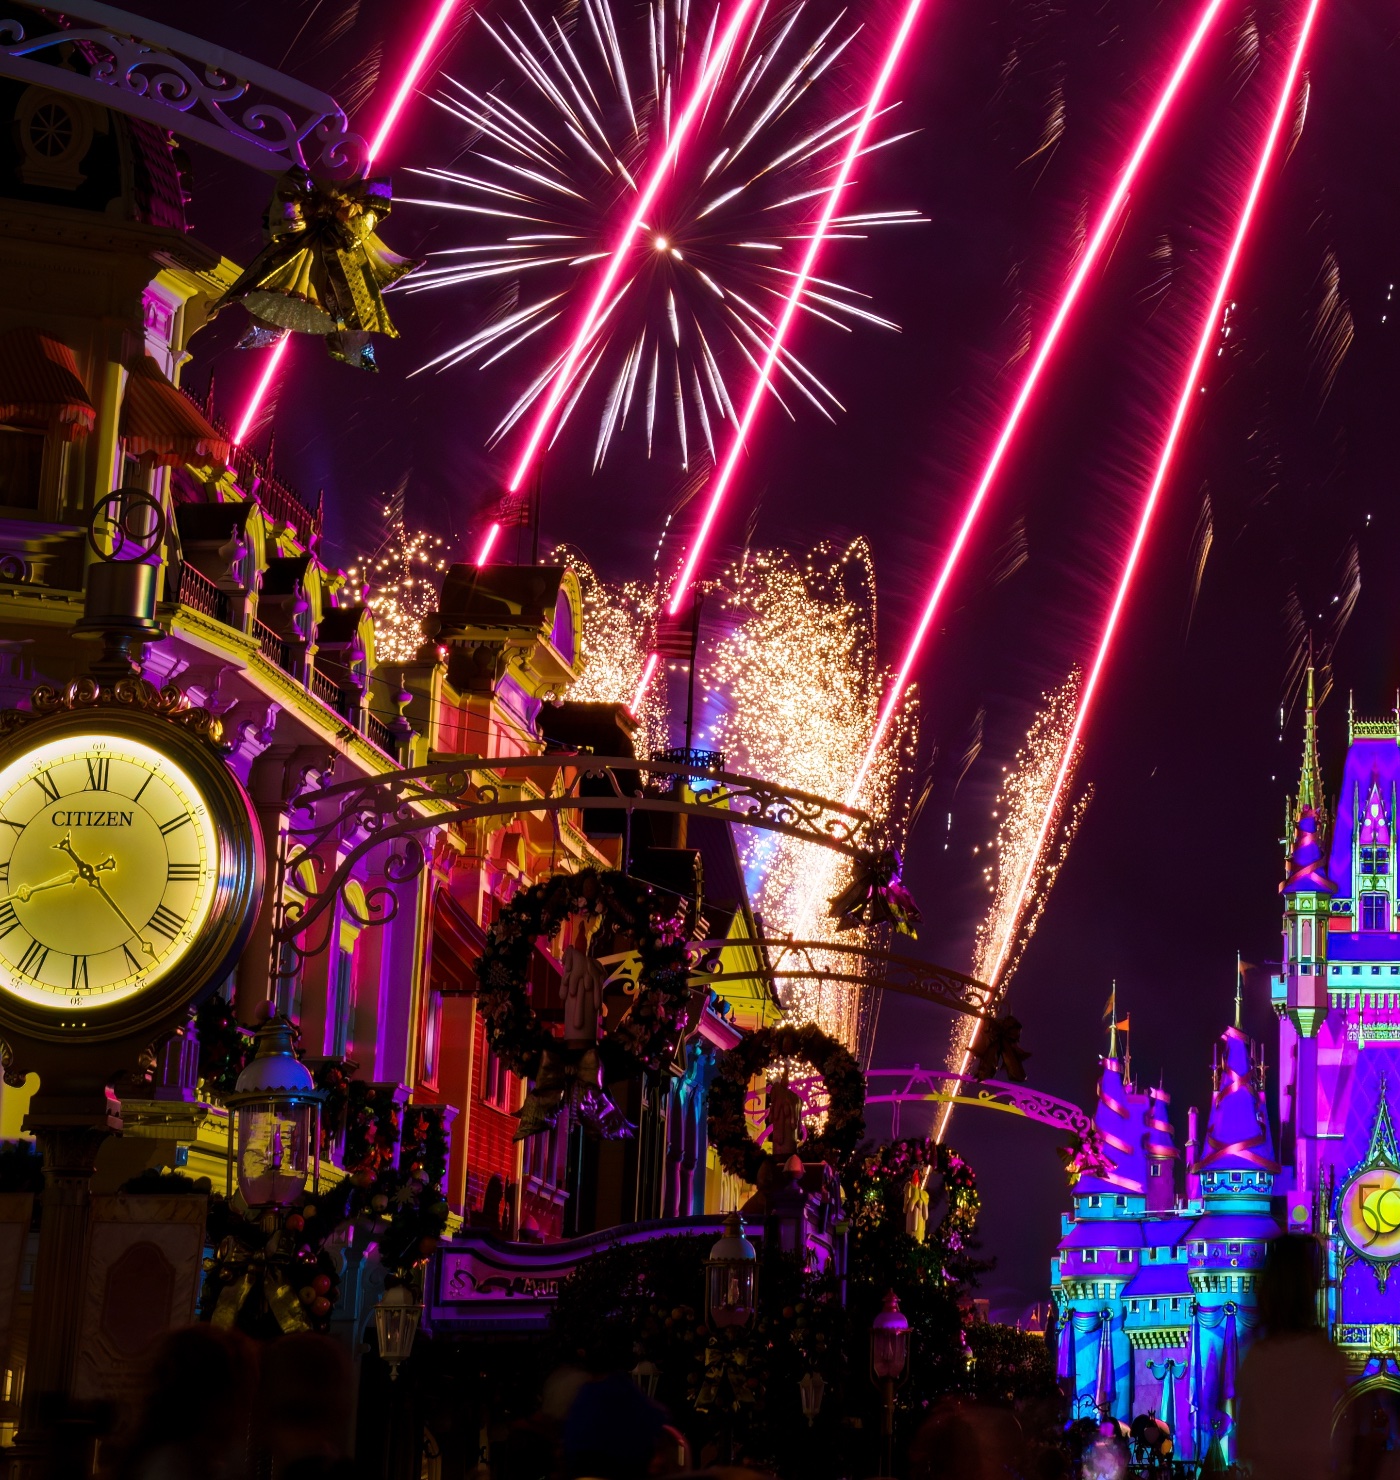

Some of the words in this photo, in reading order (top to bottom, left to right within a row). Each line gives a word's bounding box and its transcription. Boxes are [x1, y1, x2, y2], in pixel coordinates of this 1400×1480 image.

[92, 742, 106, 750] 60
[51, 810, 134, 827] CITIZEN
[521, 1277, 559, 1296] Main
